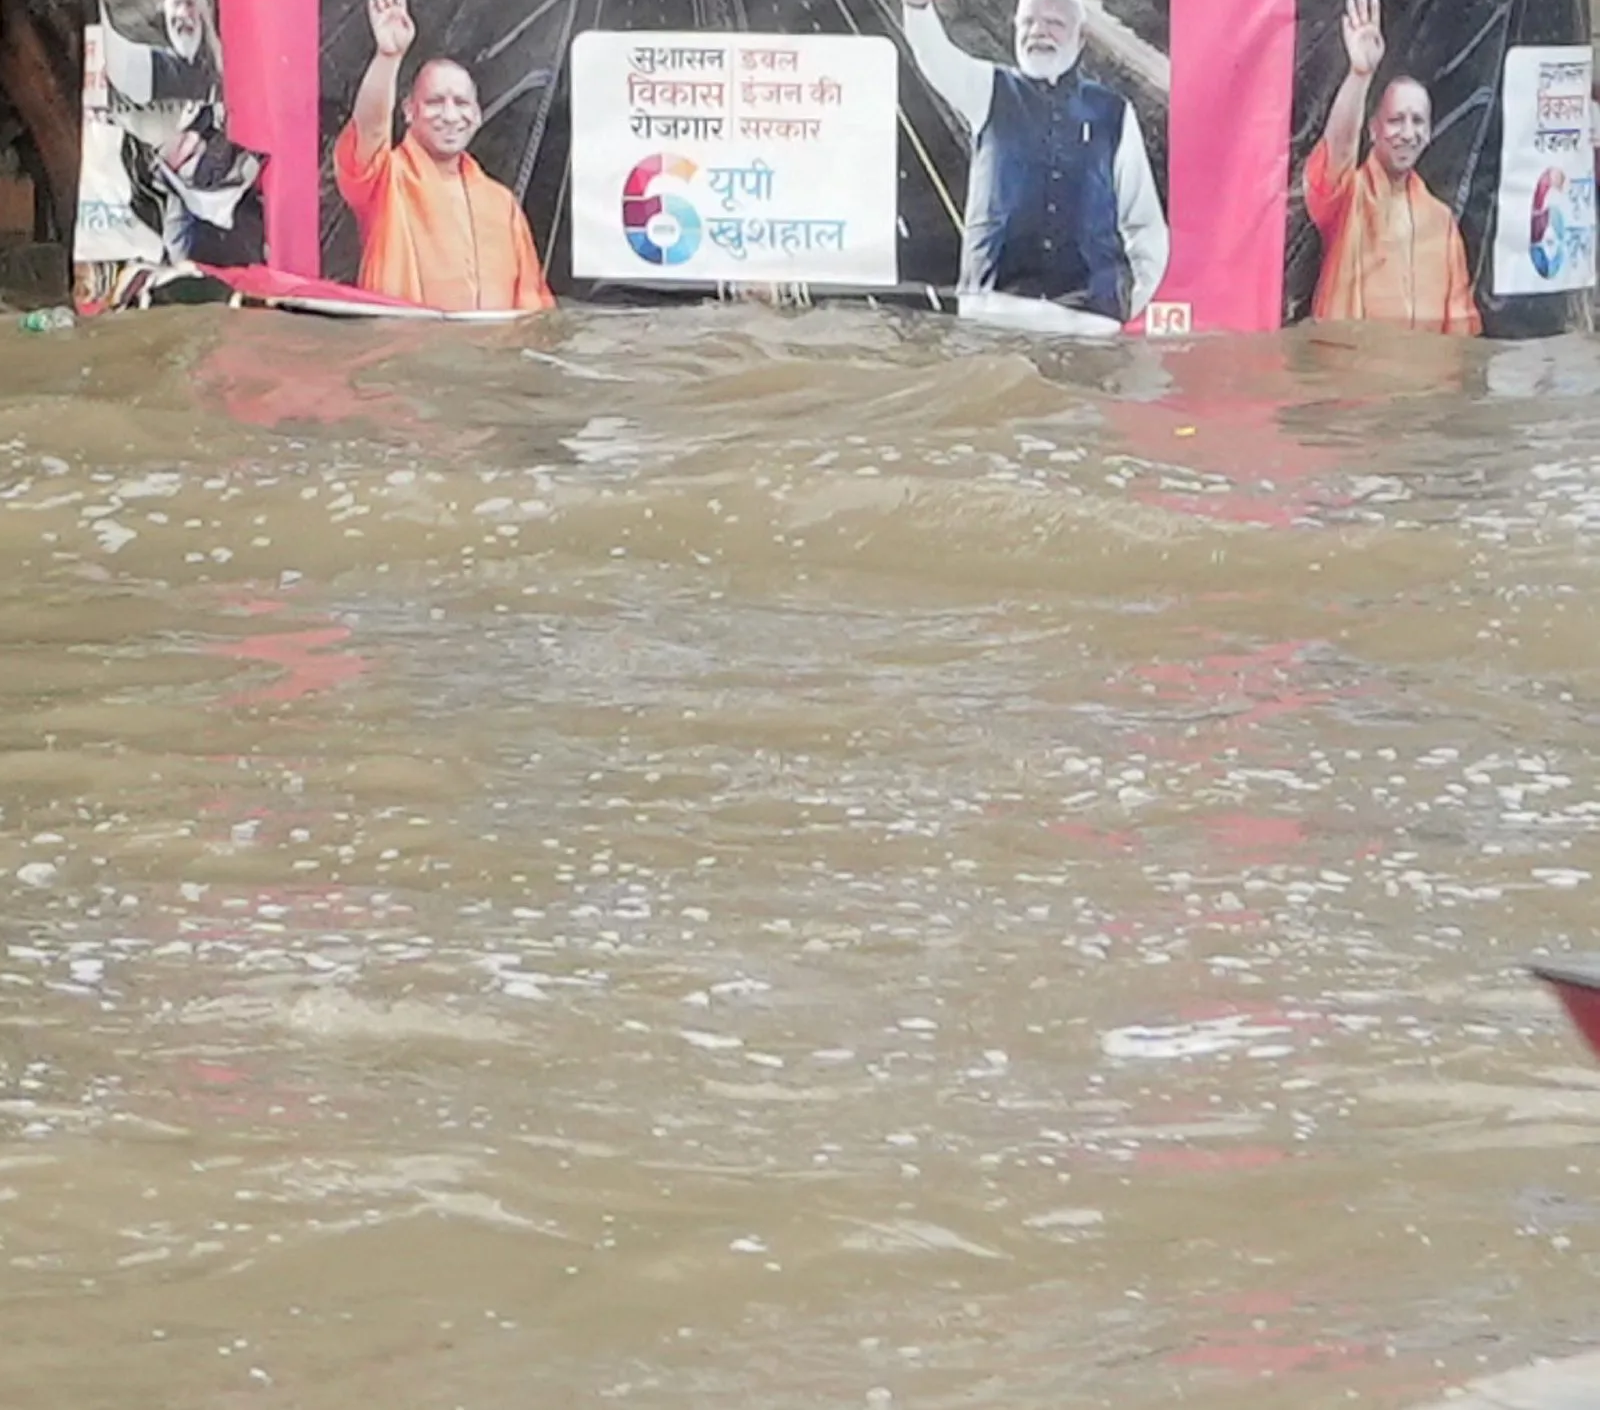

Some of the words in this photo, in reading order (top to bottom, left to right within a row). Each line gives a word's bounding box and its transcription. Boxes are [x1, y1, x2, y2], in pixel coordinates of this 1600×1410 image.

[632, 46, 726, 74] सुशासन
[627, 73, 725, 108] विकास
[740, 76, 803, 107] इंजन
[809, 75, 842, 106] की
[629, 108, 726, 141] रोजगार
[739, 117, 823, 141] सरकार
[707, 157, 775, 212] यूपी
[705, 217, 846, 261] खुशहाल
